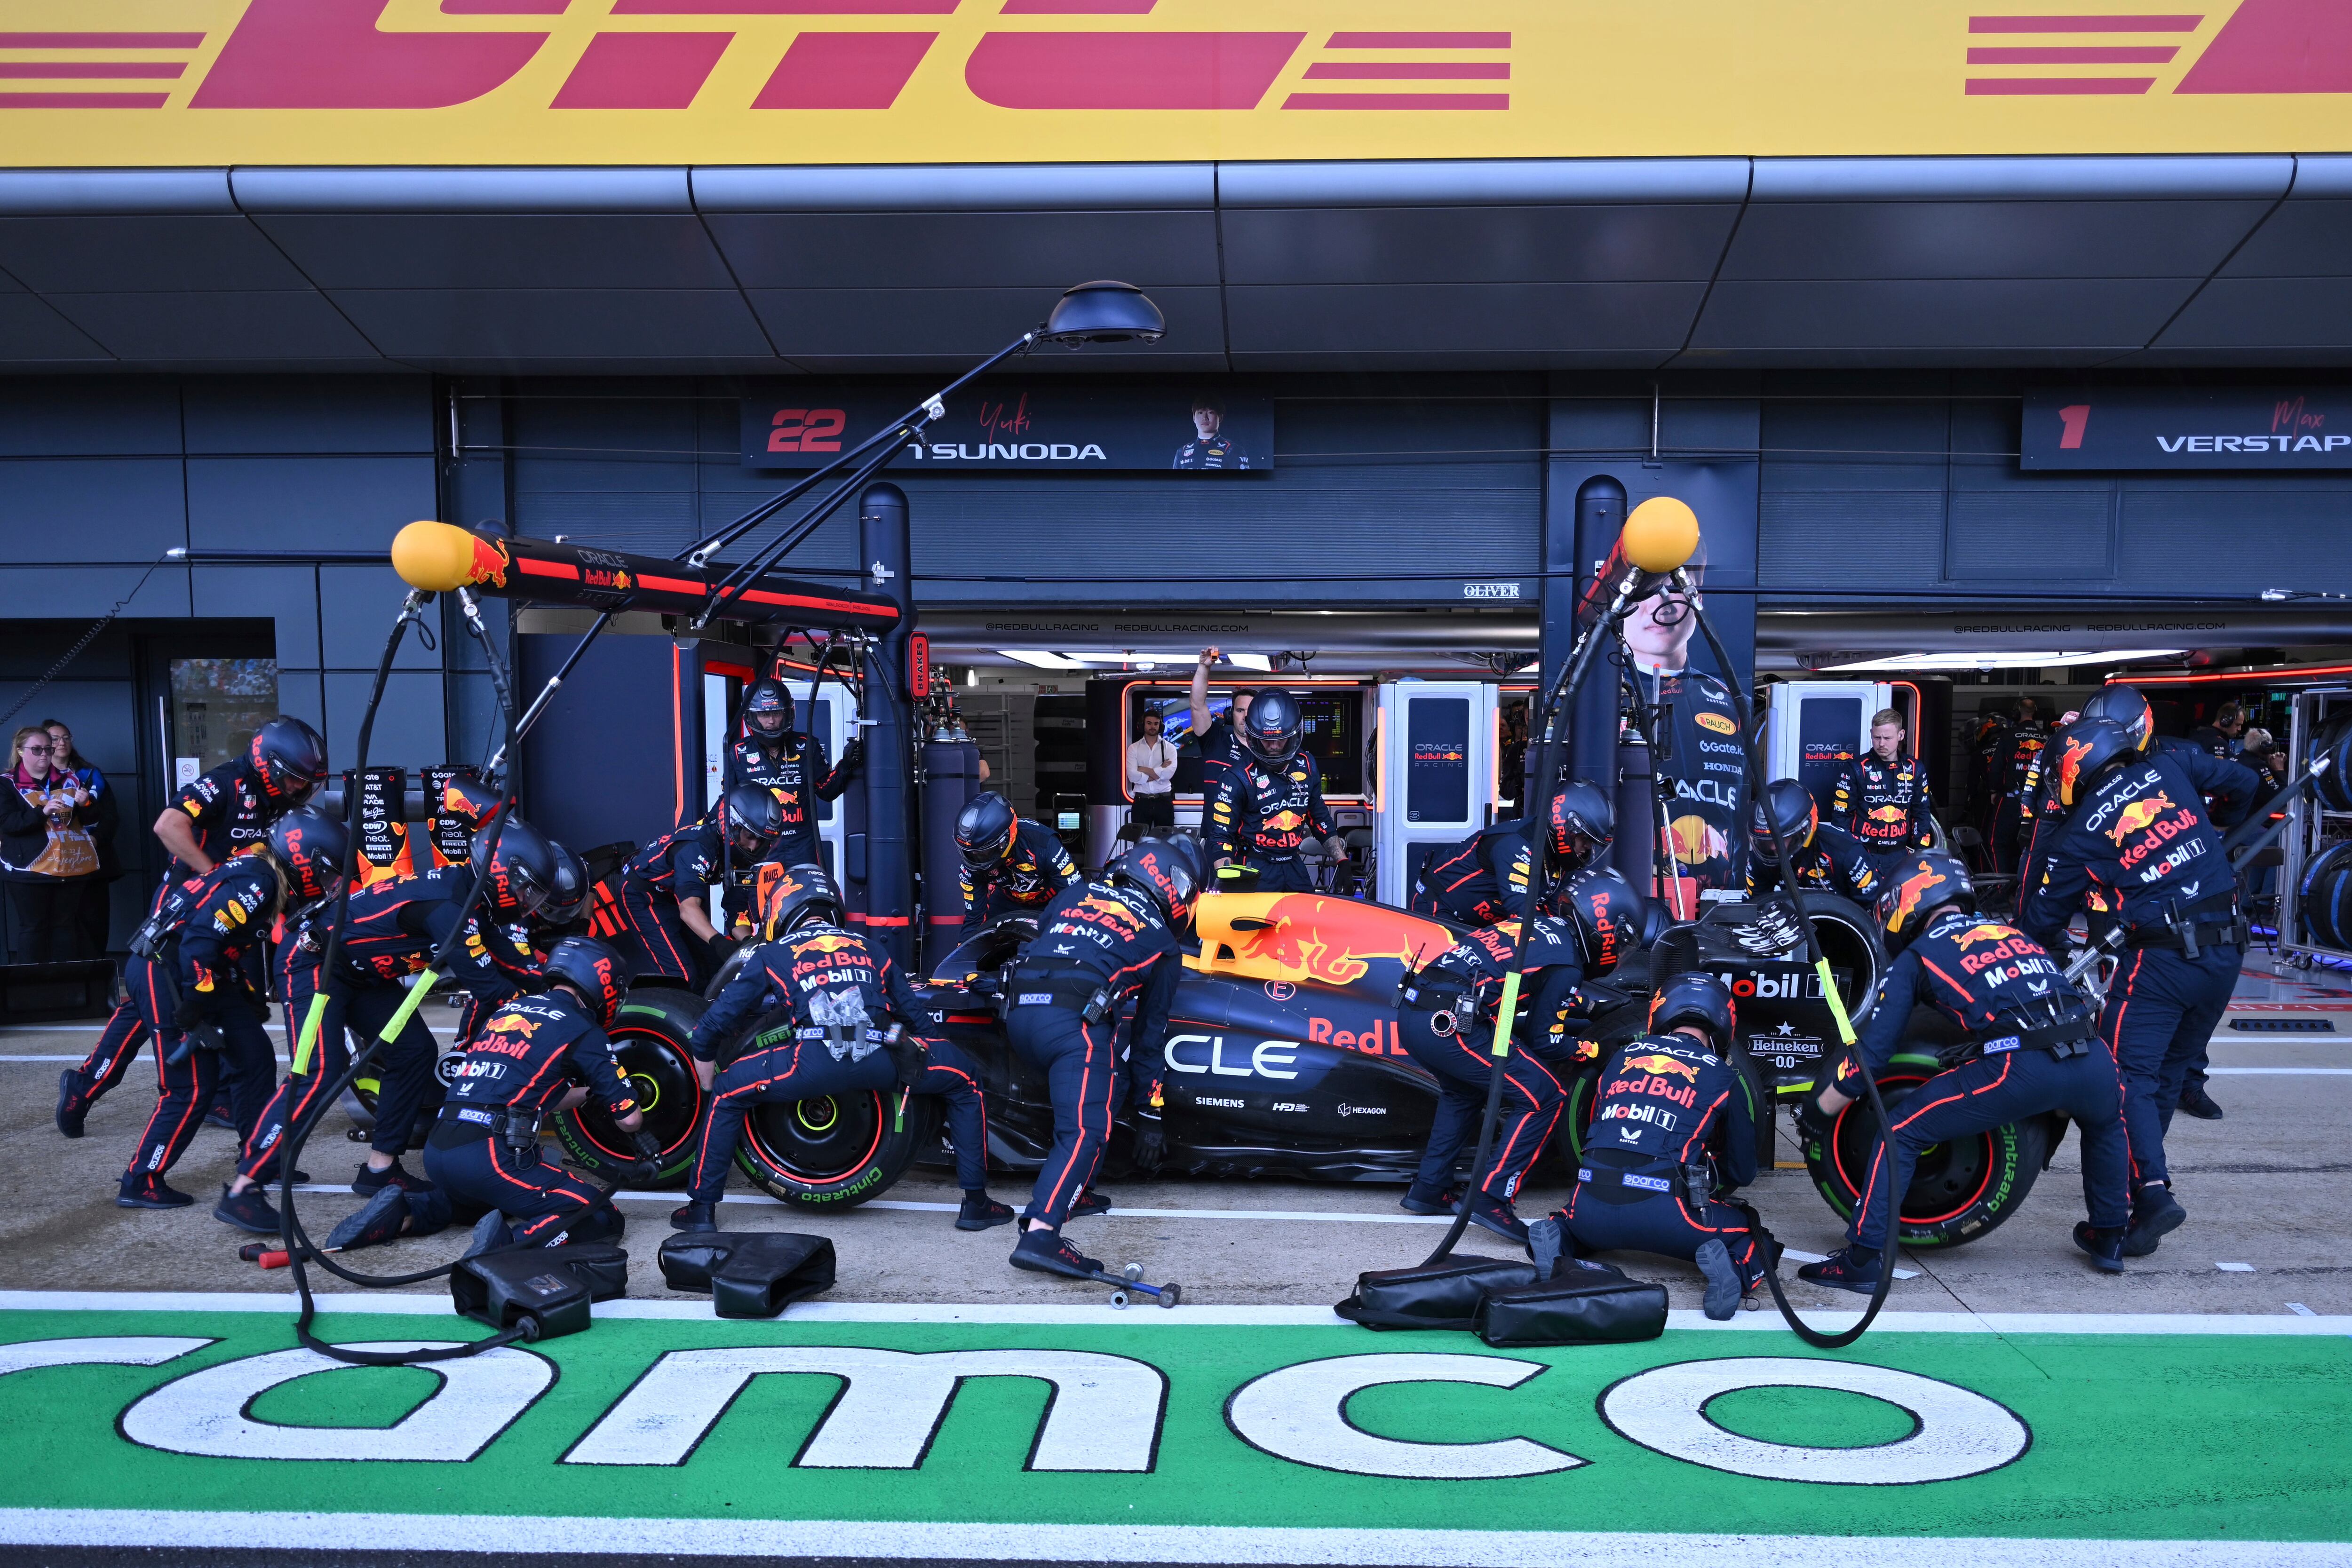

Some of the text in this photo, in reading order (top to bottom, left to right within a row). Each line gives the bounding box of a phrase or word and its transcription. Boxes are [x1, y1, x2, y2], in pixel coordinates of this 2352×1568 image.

[980, 392, 1031, 445] Yuki
[2058, 405, 2090, 448] 1
[2271, 396, 2324, 441] Max
[767, 409, 846, 451] 22
[906, 443, 1106, 459] TSUNODA
[2156, 436, 2352, 452] VERSTAP
[577, 549, 628, 569] ORACLE
[1464, 585, 1520, 597] OLIVER
[1954, 623, 2225, 634] @REDBULLRACING REDBULLRACING.COM
[1706, 718, 1731, 731] RAUCH
[1703, 762, 1742, 775] HONDA
[1257, 790, 1272, 800] Mobil
[1864, 795, 1912, 803] ORACLE
[2086, 769, 2161, 832] ORACLE
[1260, 797, 1309, 815] ORACLE
[1409, 811, 1420, 820] 3
[2158, 809, 2198, 840] Bull
[1861, 822, 1907, 837] Red Bull
[1256, 833, 1287, 847] Red
[2140, 847, 2191, 882] Mobil
[763, 869, 779, 884] BRAKES
[238, 892, 254, 913] TRAD
[1089, 883, 1162, 930] ORACLE
[1960, 940, 2013, 974] Red
[800, 969, 852, 992] Mobil
[1985, 959, 2043, 989] Mobil
[1019, 994, 1051, 1003] sparco
[756, 1025, 796, 1047] PIREL
[1984, 1037, 2018, 1051] sparco
[494, 1035, 531, 1060] Bull
[1624, 1042, 1718, 1066] ORACLE
[1753, 1040, 1818, 1053] Heineken
[1776, 1056, 1795, 1068] 0.0
[1651, 1077, 1697, 1109] Bull
[1196, 1097, 1244, 1108] SIEMENS
[1601, 1104, 1655, 1123] Mobil
[1624, 1174, 1669, 1191] sparco
